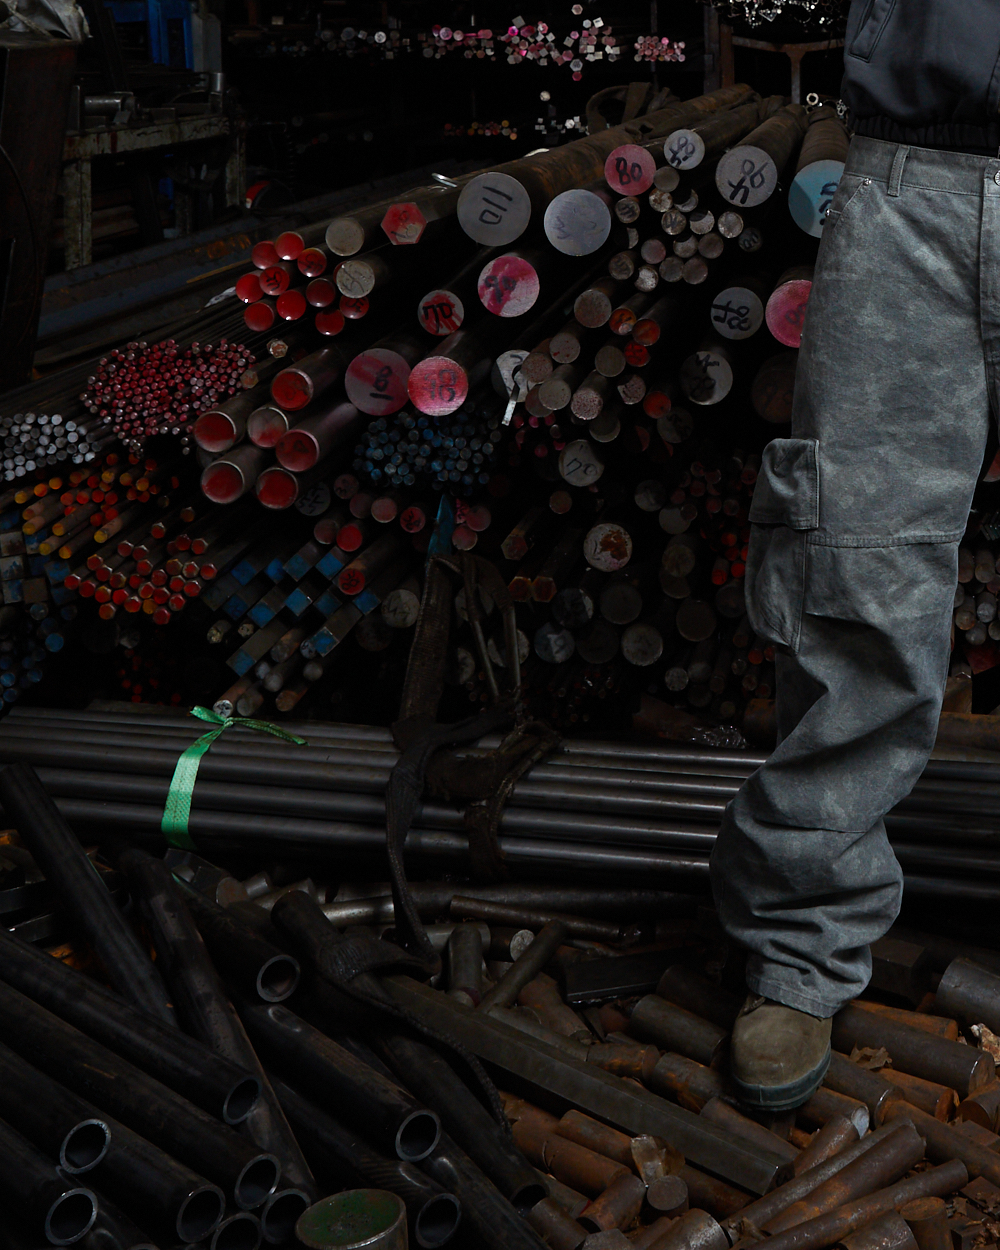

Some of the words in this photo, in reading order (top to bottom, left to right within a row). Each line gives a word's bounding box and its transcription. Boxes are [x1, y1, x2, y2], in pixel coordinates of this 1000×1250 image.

[615, 156, 643, 186] 80
[485, 275, 516, 303] 90
[422, 302, 452, 333] 70
